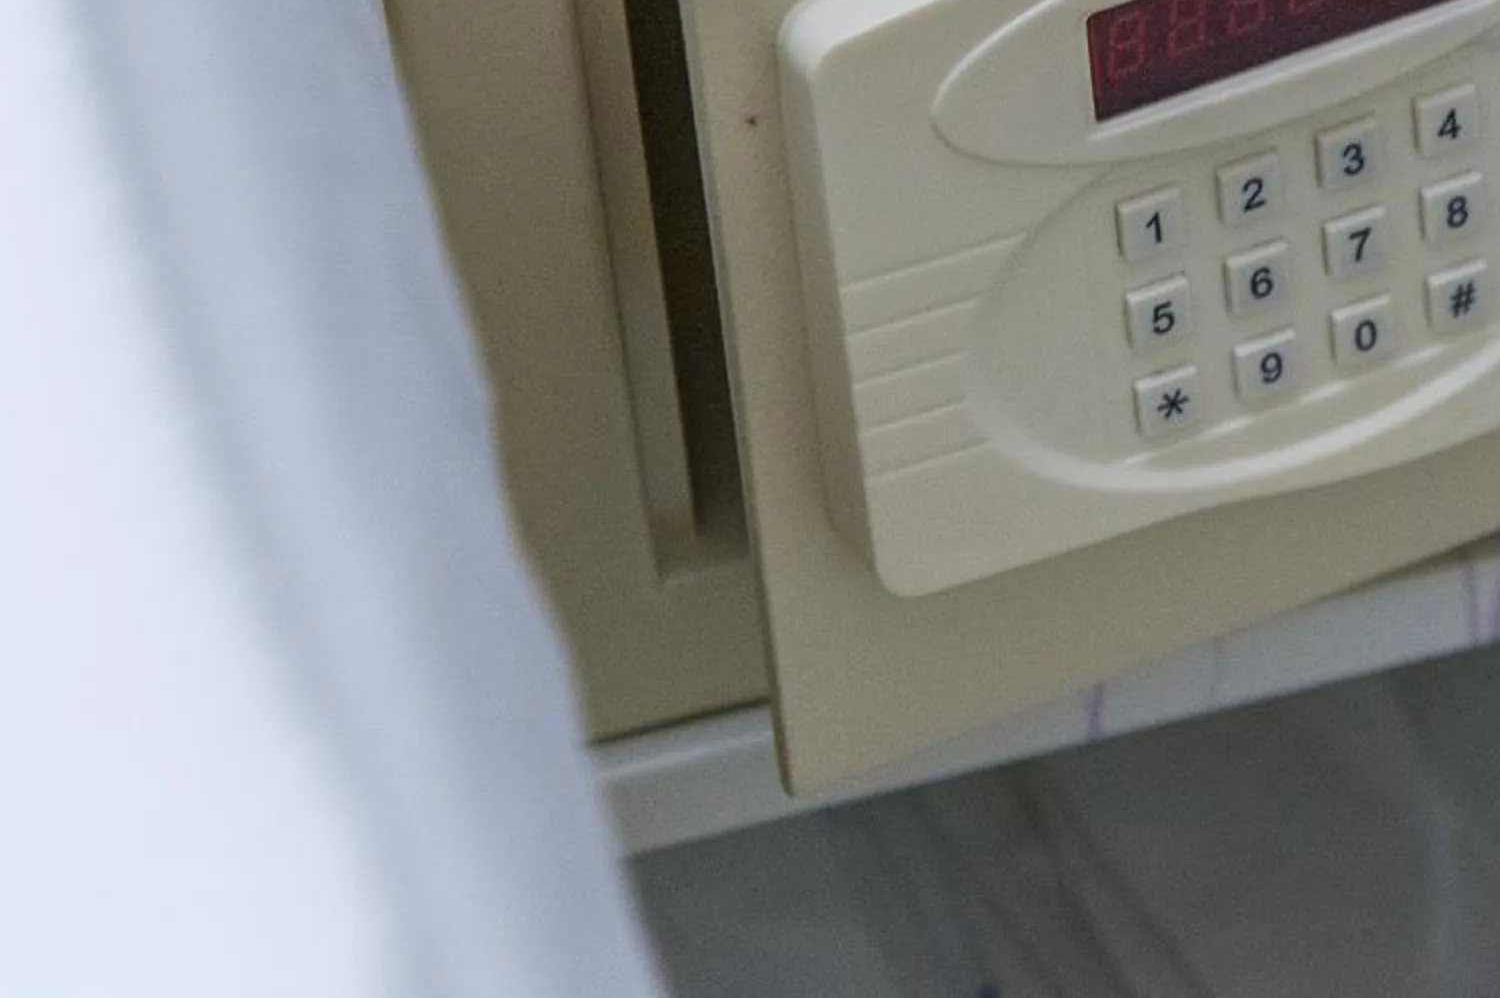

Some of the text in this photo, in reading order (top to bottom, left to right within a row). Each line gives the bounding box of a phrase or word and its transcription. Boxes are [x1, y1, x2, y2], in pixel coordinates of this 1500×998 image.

[1145, 109, 1462, 243] 1 2 3 4
[1152, 195, 1469, 335] 5 6 7 8
[1260, 352, 1283, 384] 9
[1354, 319, 1378, 352] 0
